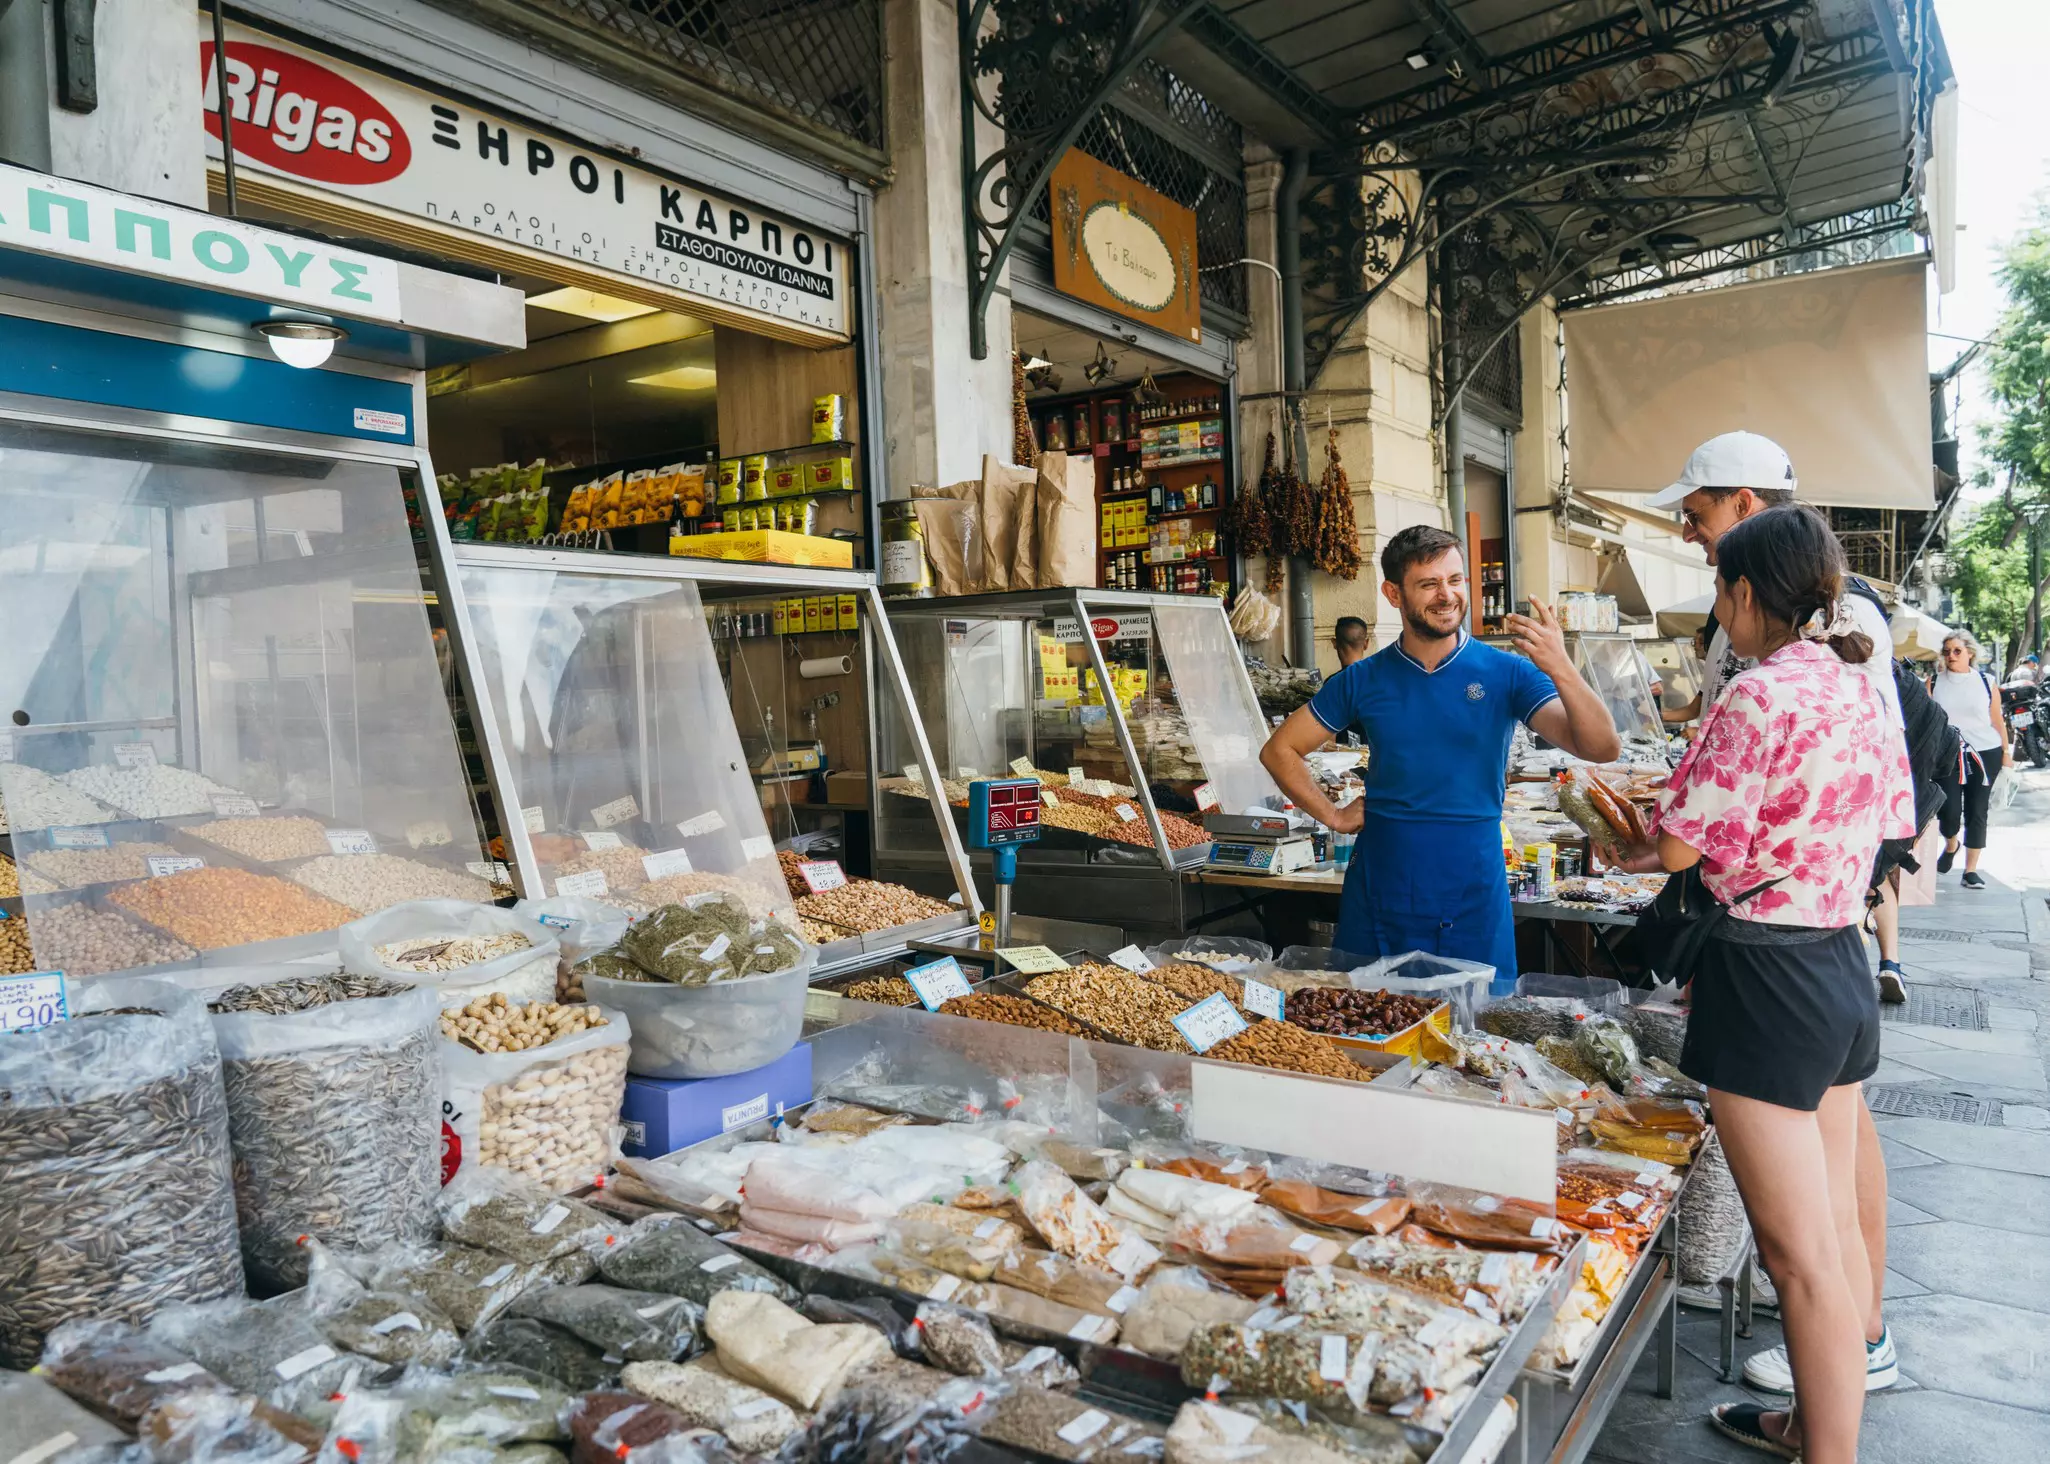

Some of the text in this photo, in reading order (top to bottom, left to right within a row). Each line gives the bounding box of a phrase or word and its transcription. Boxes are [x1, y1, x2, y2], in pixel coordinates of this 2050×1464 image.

[204, 52, 393, 164] Rigas
[431, 104, 832, 272] ΞΗΡΟΙ ΚΑΡΠΟΙ
[0, 187, 373, 303] ΠΠΟΥΣ
[426, 202, 834, 328] ΠΑΡΑΓΩΓΗΣ ΕΡΓΟΣΤΑΣΙΟΥ ΜΑΣ
[484, 203, 799, 305] ΟΛΟΙ ΟΙ ΞΗΡΟΙ ΚΑΡΠΟΙ
[660, 229, 830, 296] ΣΤΑΘΟΠΟΥΛΟΥ ΙΩΑΝΝΑ
[1056, 631, 1082, 639] ΚΑΡΠΟ
[1057, 623, 1081, 631] ΞΗΡΟ
[1092, 623, 1114, 633] Rigas
[1120, 617, 1149, 625] ΚΑΡΑΜΕΛΕΣ
[984, 916, 991, 927] 2
[727, 1104, 764, 1124] PRUNITA
